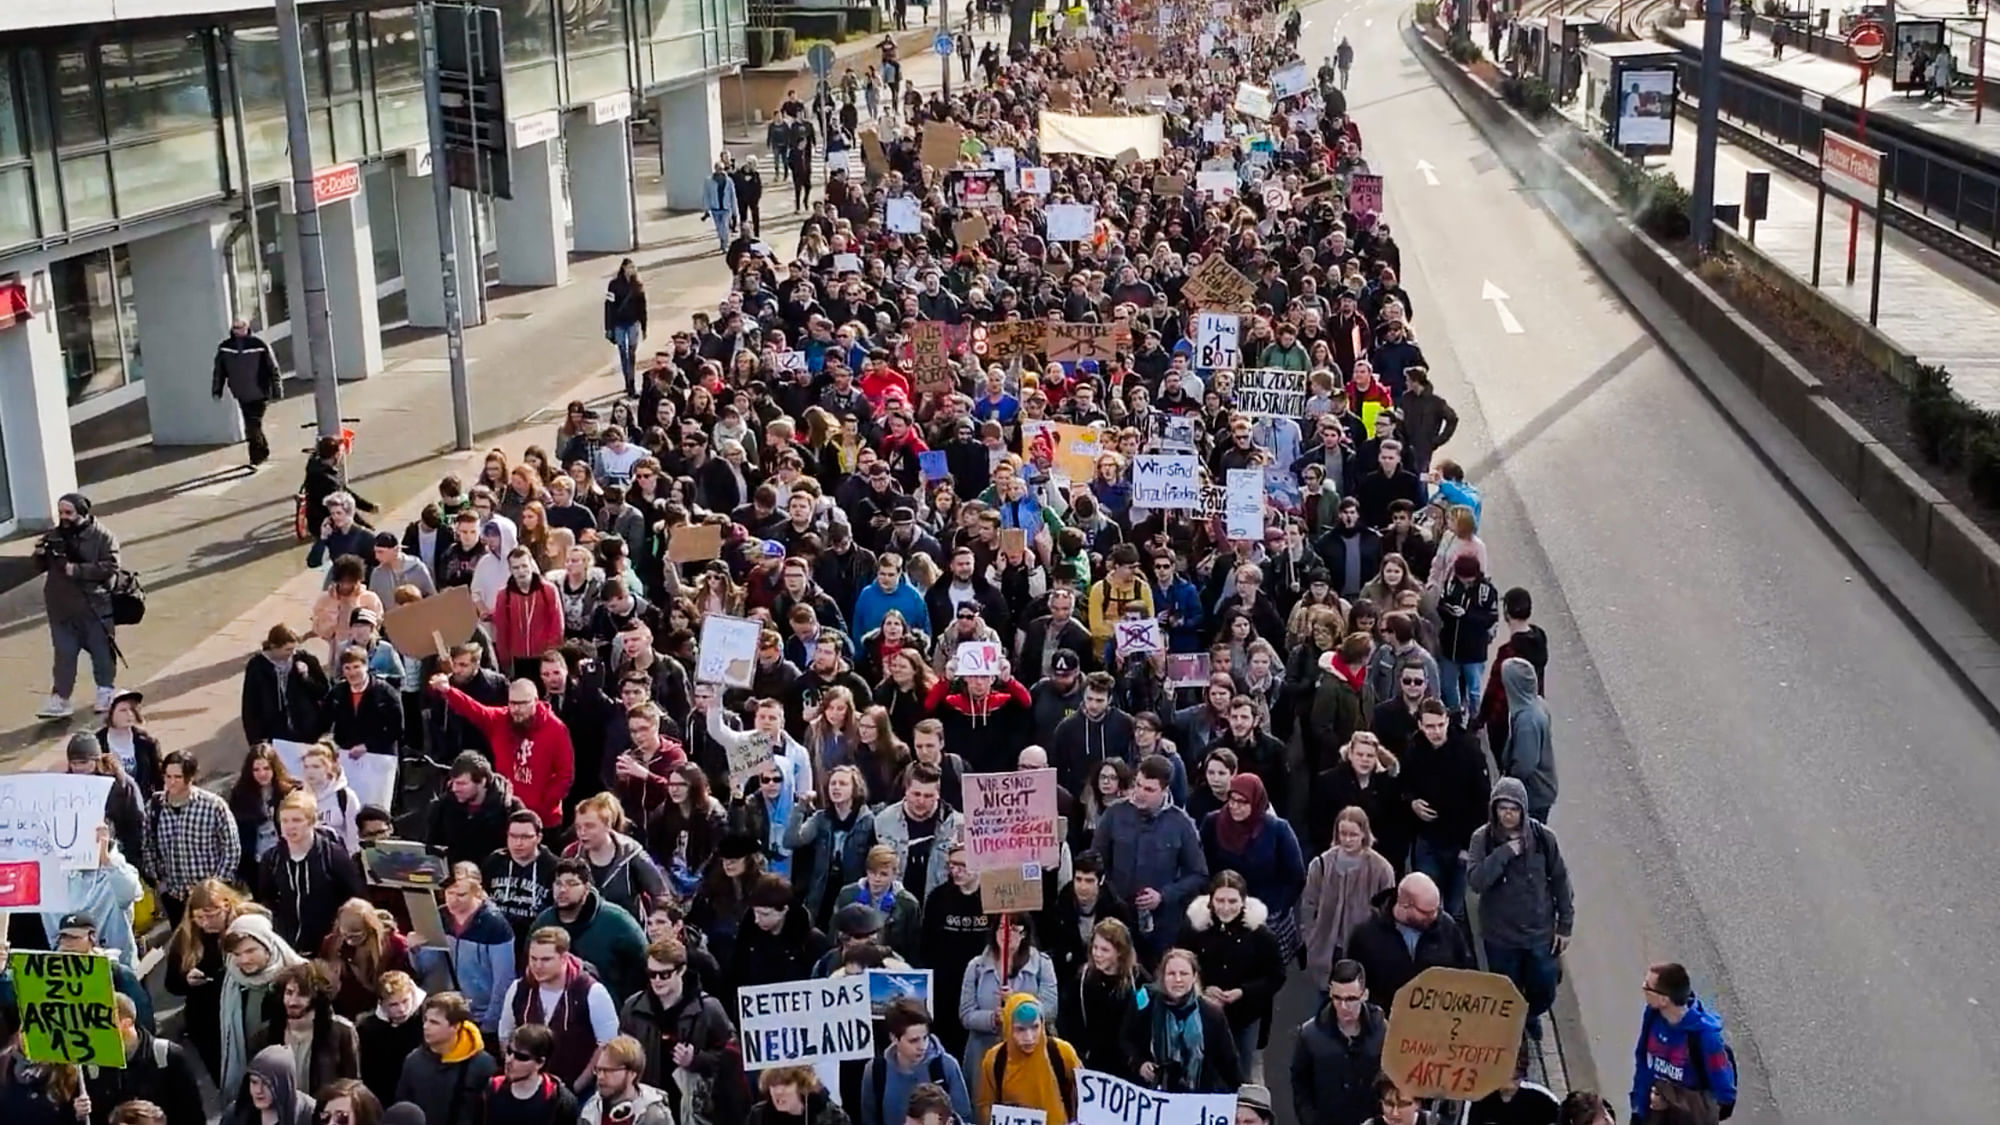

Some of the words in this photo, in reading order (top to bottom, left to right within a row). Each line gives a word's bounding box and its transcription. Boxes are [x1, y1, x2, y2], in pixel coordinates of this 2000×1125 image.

[1202, 345, 1236, 367] BOT
[1168, 462, 1193, 478] sind
[1201, 486, 1227, 499] SAV
[984, 789, 1036, 808] NICHT
[24, 954, 94, 978] NEIN
[45, 980, 83, 999] ZU
[741, 991, 812, 1018] RETTET
[821, 984, 864, 1008] DAS
[1410, 987, 1514, 1018] DEMOKRATIE
[23, 1002, 117, 1034] ARTIKEL
[51, 1029, 95, 1062] 13
[744, 1018, 870, 1063] NEULAND
[1401, 1039, 1437, 1055] DANN
[1448, 1046, 1506, 1064] STOPPT
[1081, 1075, 1170, 1125] STOPPT
